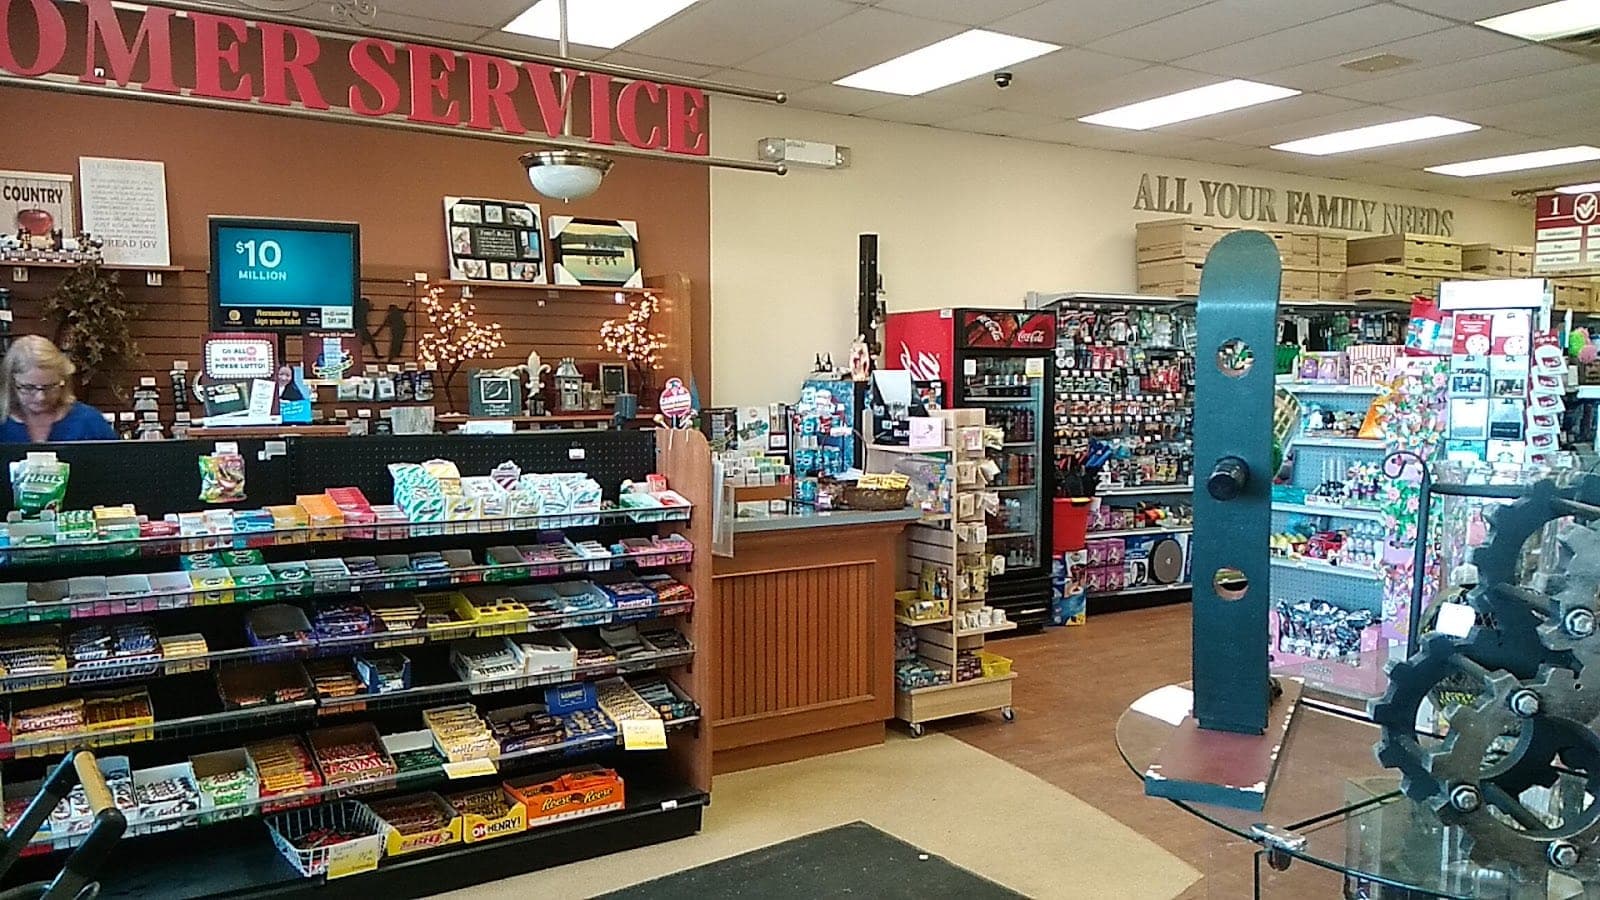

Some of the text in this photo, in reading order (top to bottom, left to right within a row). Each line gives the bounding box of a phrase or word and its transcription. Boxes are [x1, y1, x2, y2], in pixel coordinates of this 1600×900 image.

[349, 38, 710, 156] SERVICE
[3, 185, 64, 204] COUNTRY
[1133, 172, 1454, 238] ALL YOUR FAMILY NEEDS
[1551, 197, 1561, 216] 1
[235, 239, 282, 268] $10
[238, 270, 287, 281] MILLION
[24, 472, 65, 485] HALLS
[471, 815, 521, 838] OH HENRY!
